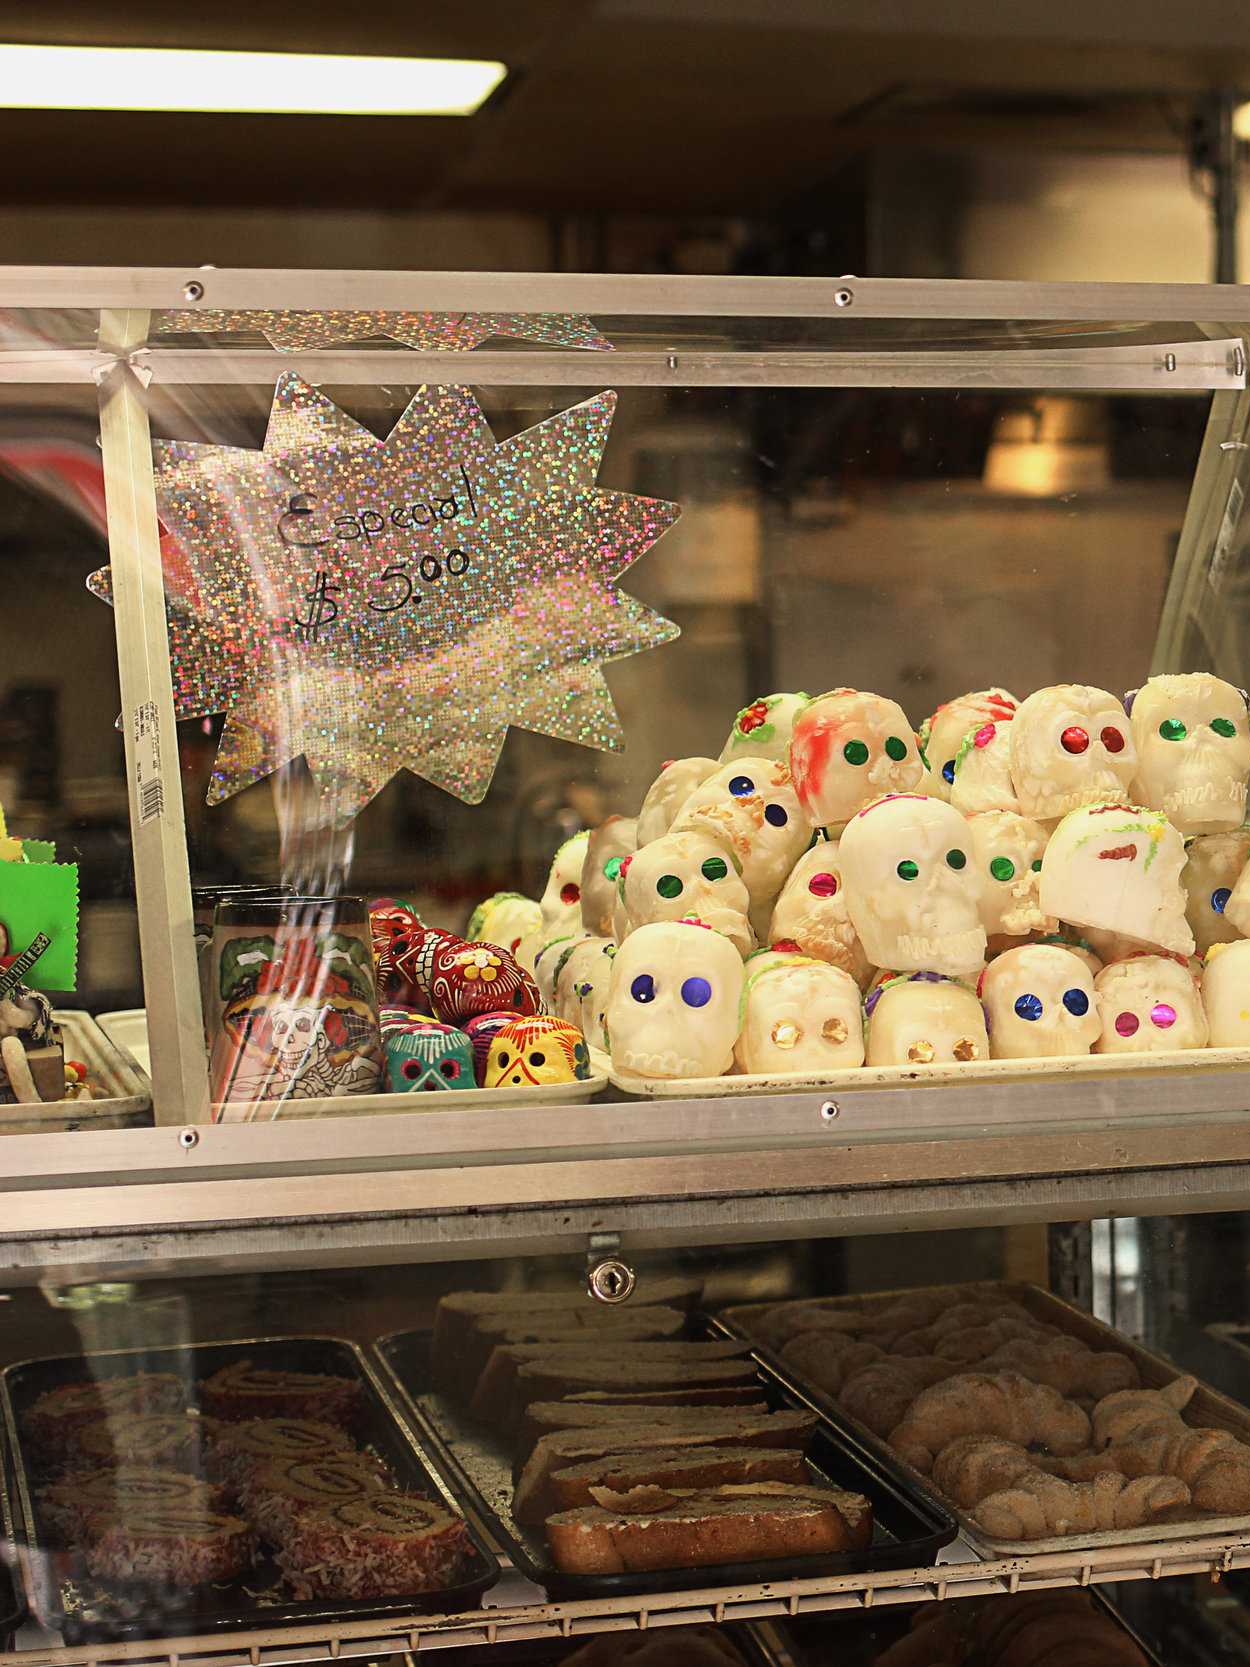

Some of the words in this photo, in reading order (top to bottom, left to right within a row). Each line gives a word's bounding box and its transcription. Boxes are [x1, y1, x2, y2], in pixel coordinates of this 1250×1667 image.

[278, 464, 477, 548] Especial
[295, 571, 341, 642] $
[367, 549, 470, 612] 5.00
